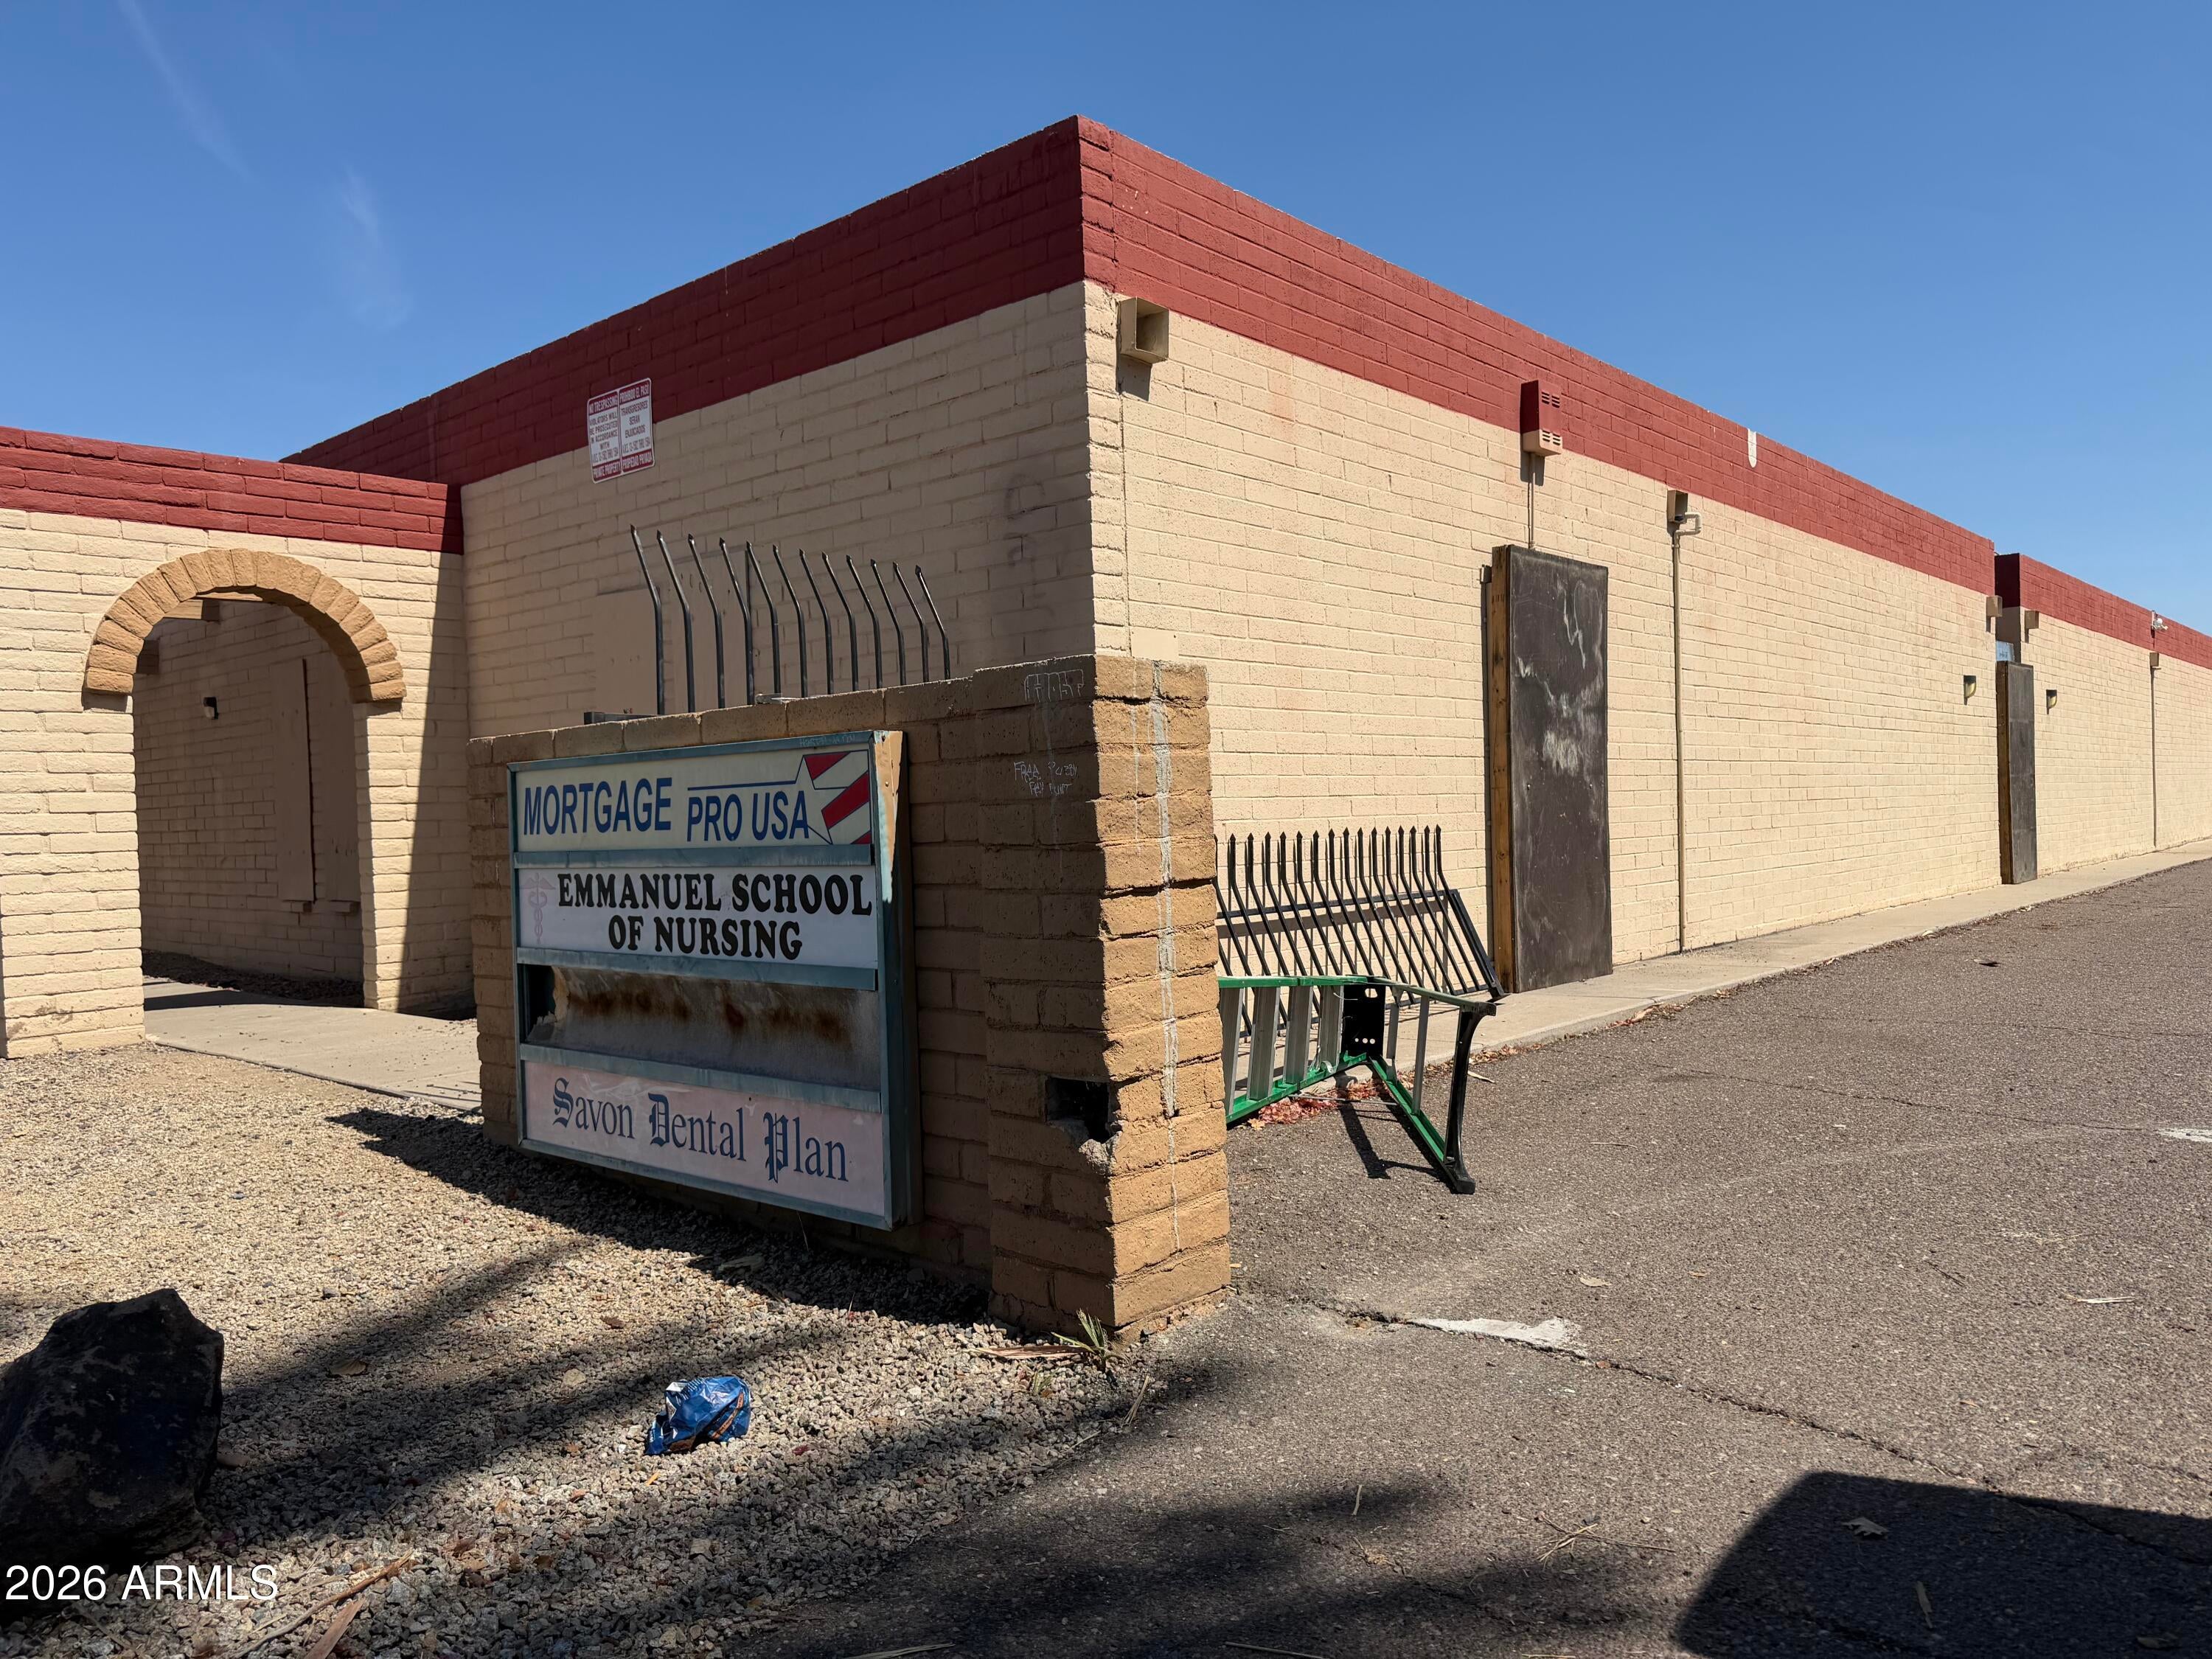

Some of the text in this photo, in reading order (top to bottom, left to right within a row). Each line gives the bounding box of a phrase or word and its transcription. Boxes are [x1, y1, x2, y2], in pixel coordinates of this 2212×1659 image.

[524, 777, 810, 842] MORTGAGE PRO USA
[558, 874, 872, 916] EMMANUEL SCHOOL
[608, 916, 802, 960] OF NURSING
[552, 1077, 849, 1183] Savon Dental Plan
